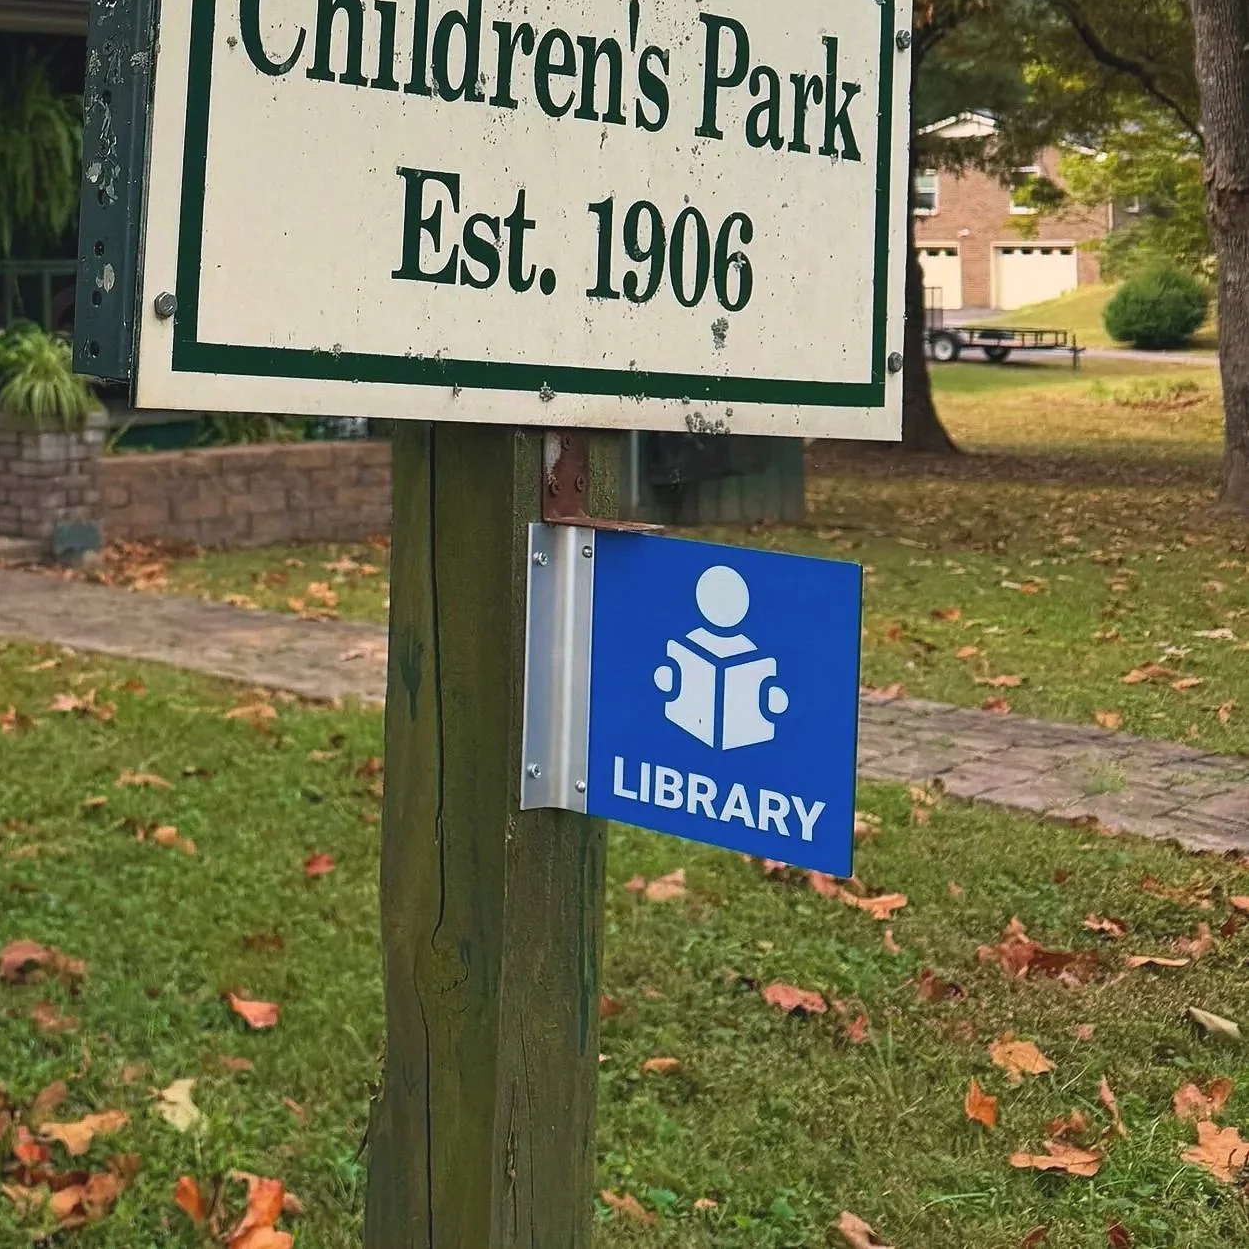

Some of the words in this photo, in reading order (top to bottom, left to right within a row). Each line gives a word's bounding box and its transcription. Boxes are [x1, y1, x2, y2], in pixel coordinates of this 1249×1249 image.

[694, 12, 862, 163] Park
[391, 166, 557, 297] Est.
[585, 196, 754, 313] 1906
[612, 756, 826, 842] LIBRARY
